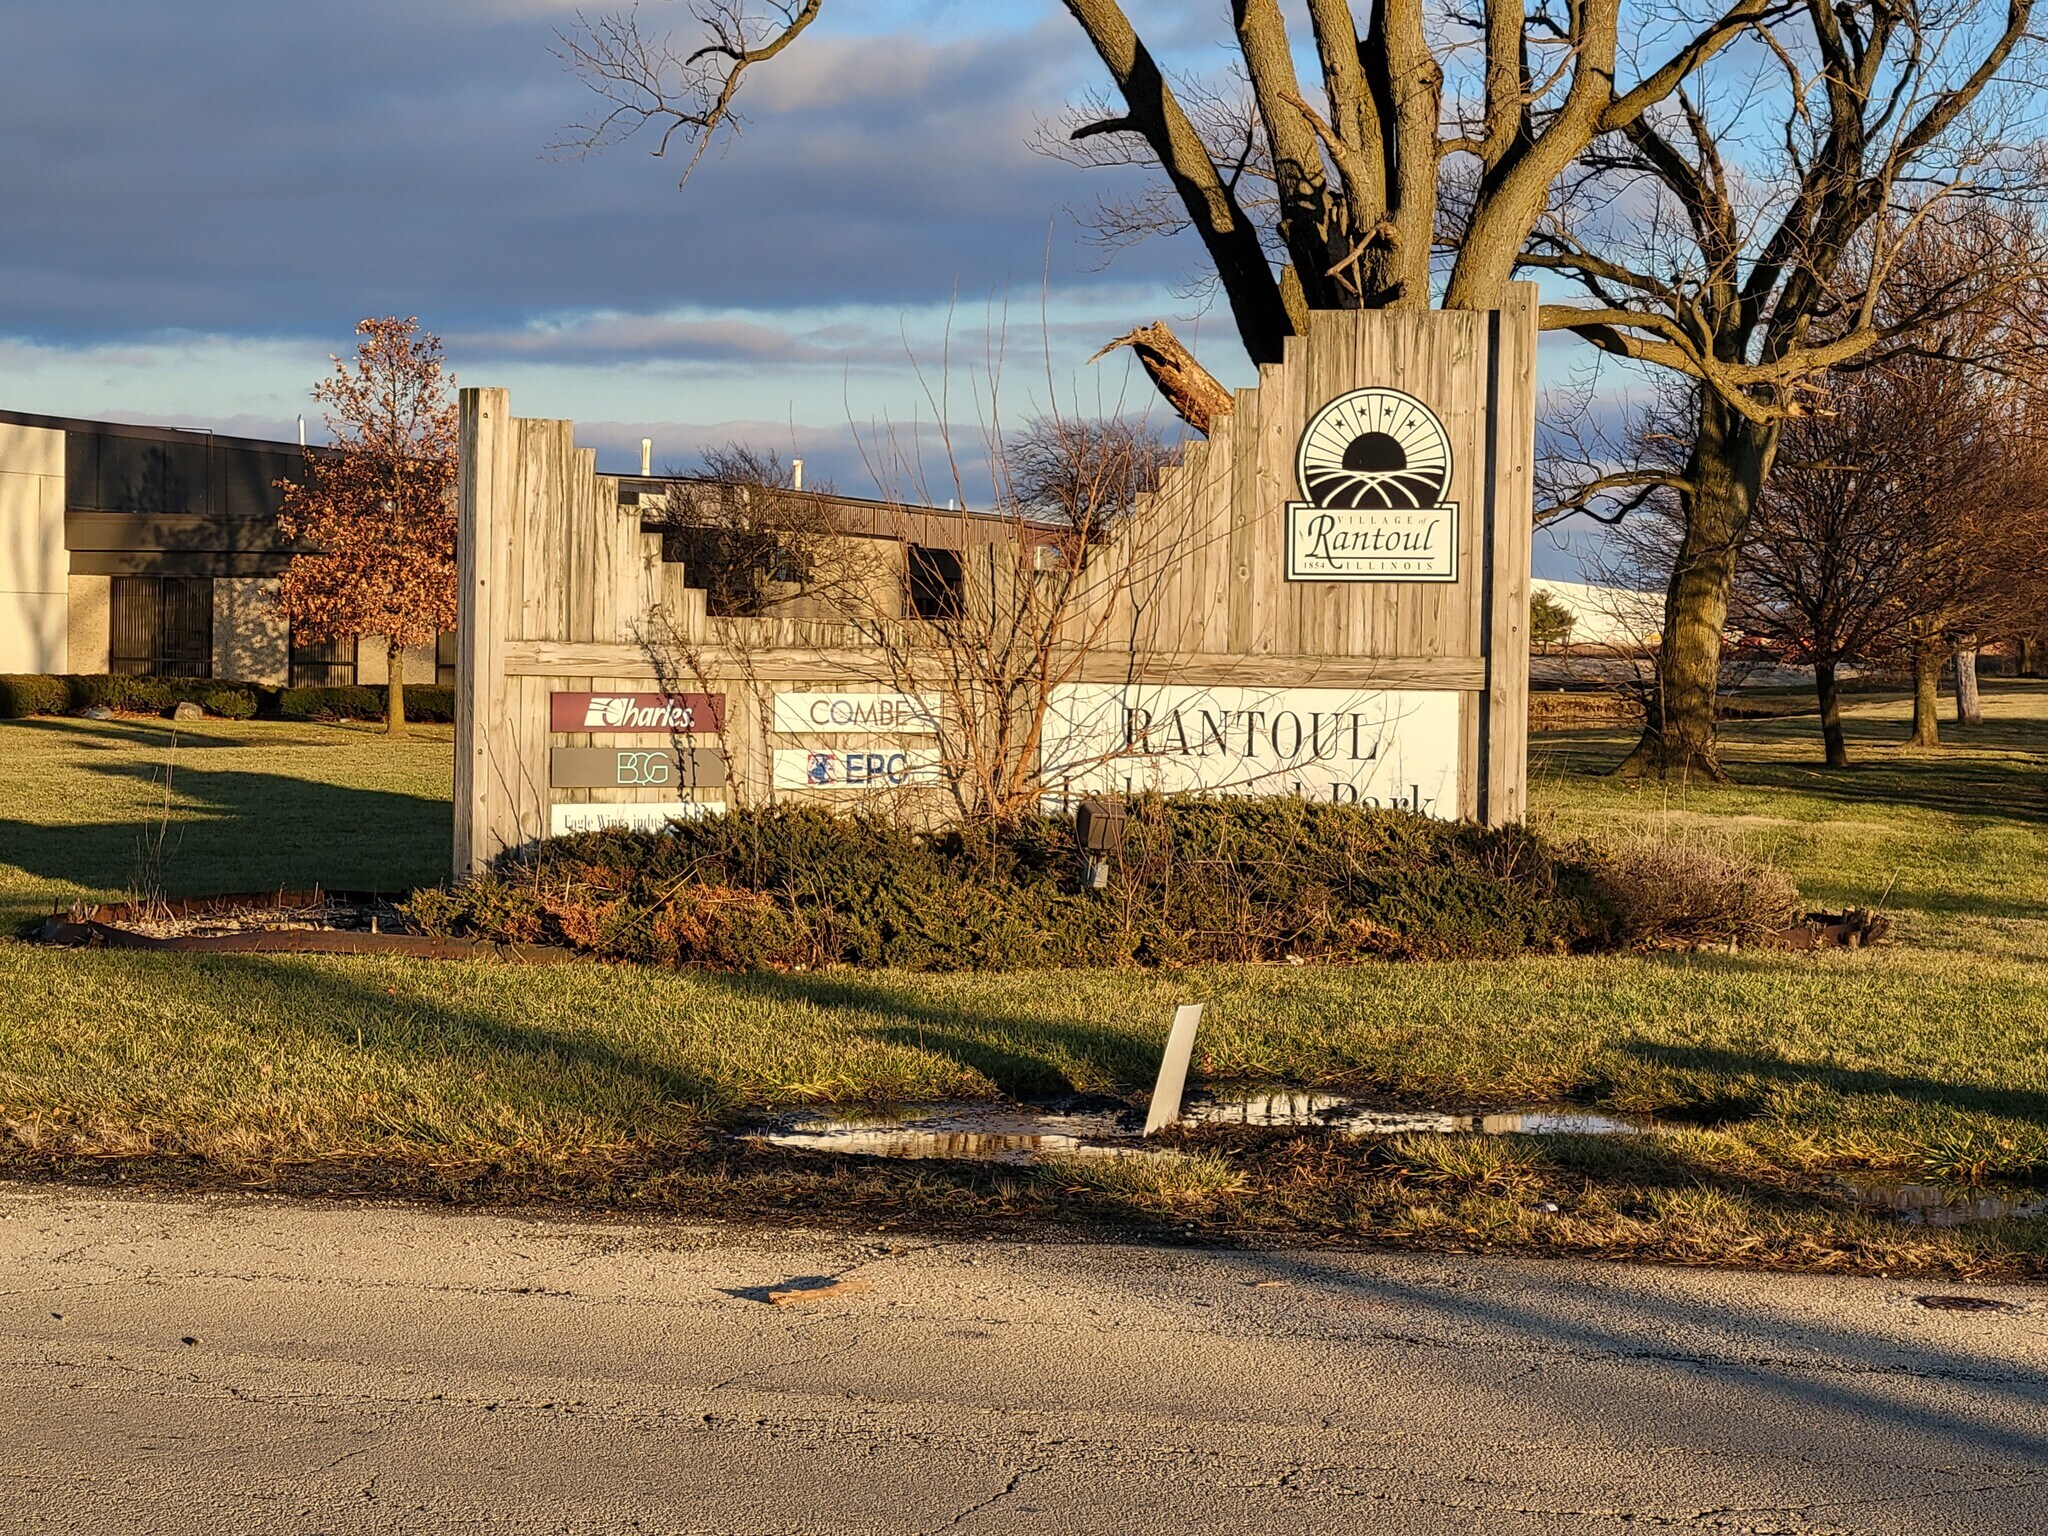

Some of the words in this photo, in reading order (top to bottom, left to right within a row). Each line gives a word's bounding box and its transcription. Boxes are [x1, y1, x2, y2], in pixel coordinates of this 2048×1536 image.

[1337, 516, 1413, 525] VILLAGE
[1418, 516, 1429, 525] of
[1304, 513, 1441, 570] Rantoul
[1303, 561, 1326, 569] 1854
[1346, 561, 1434, 571] ILLINOIS
[809, 699, 908, 727] COMBE
[1122, 707, 1379, 761] RANTOUL
[846, 753, 910, 785] EPC
[564, 814, 594, 830] Eagle
[597, 814, 629, 829] Wings
